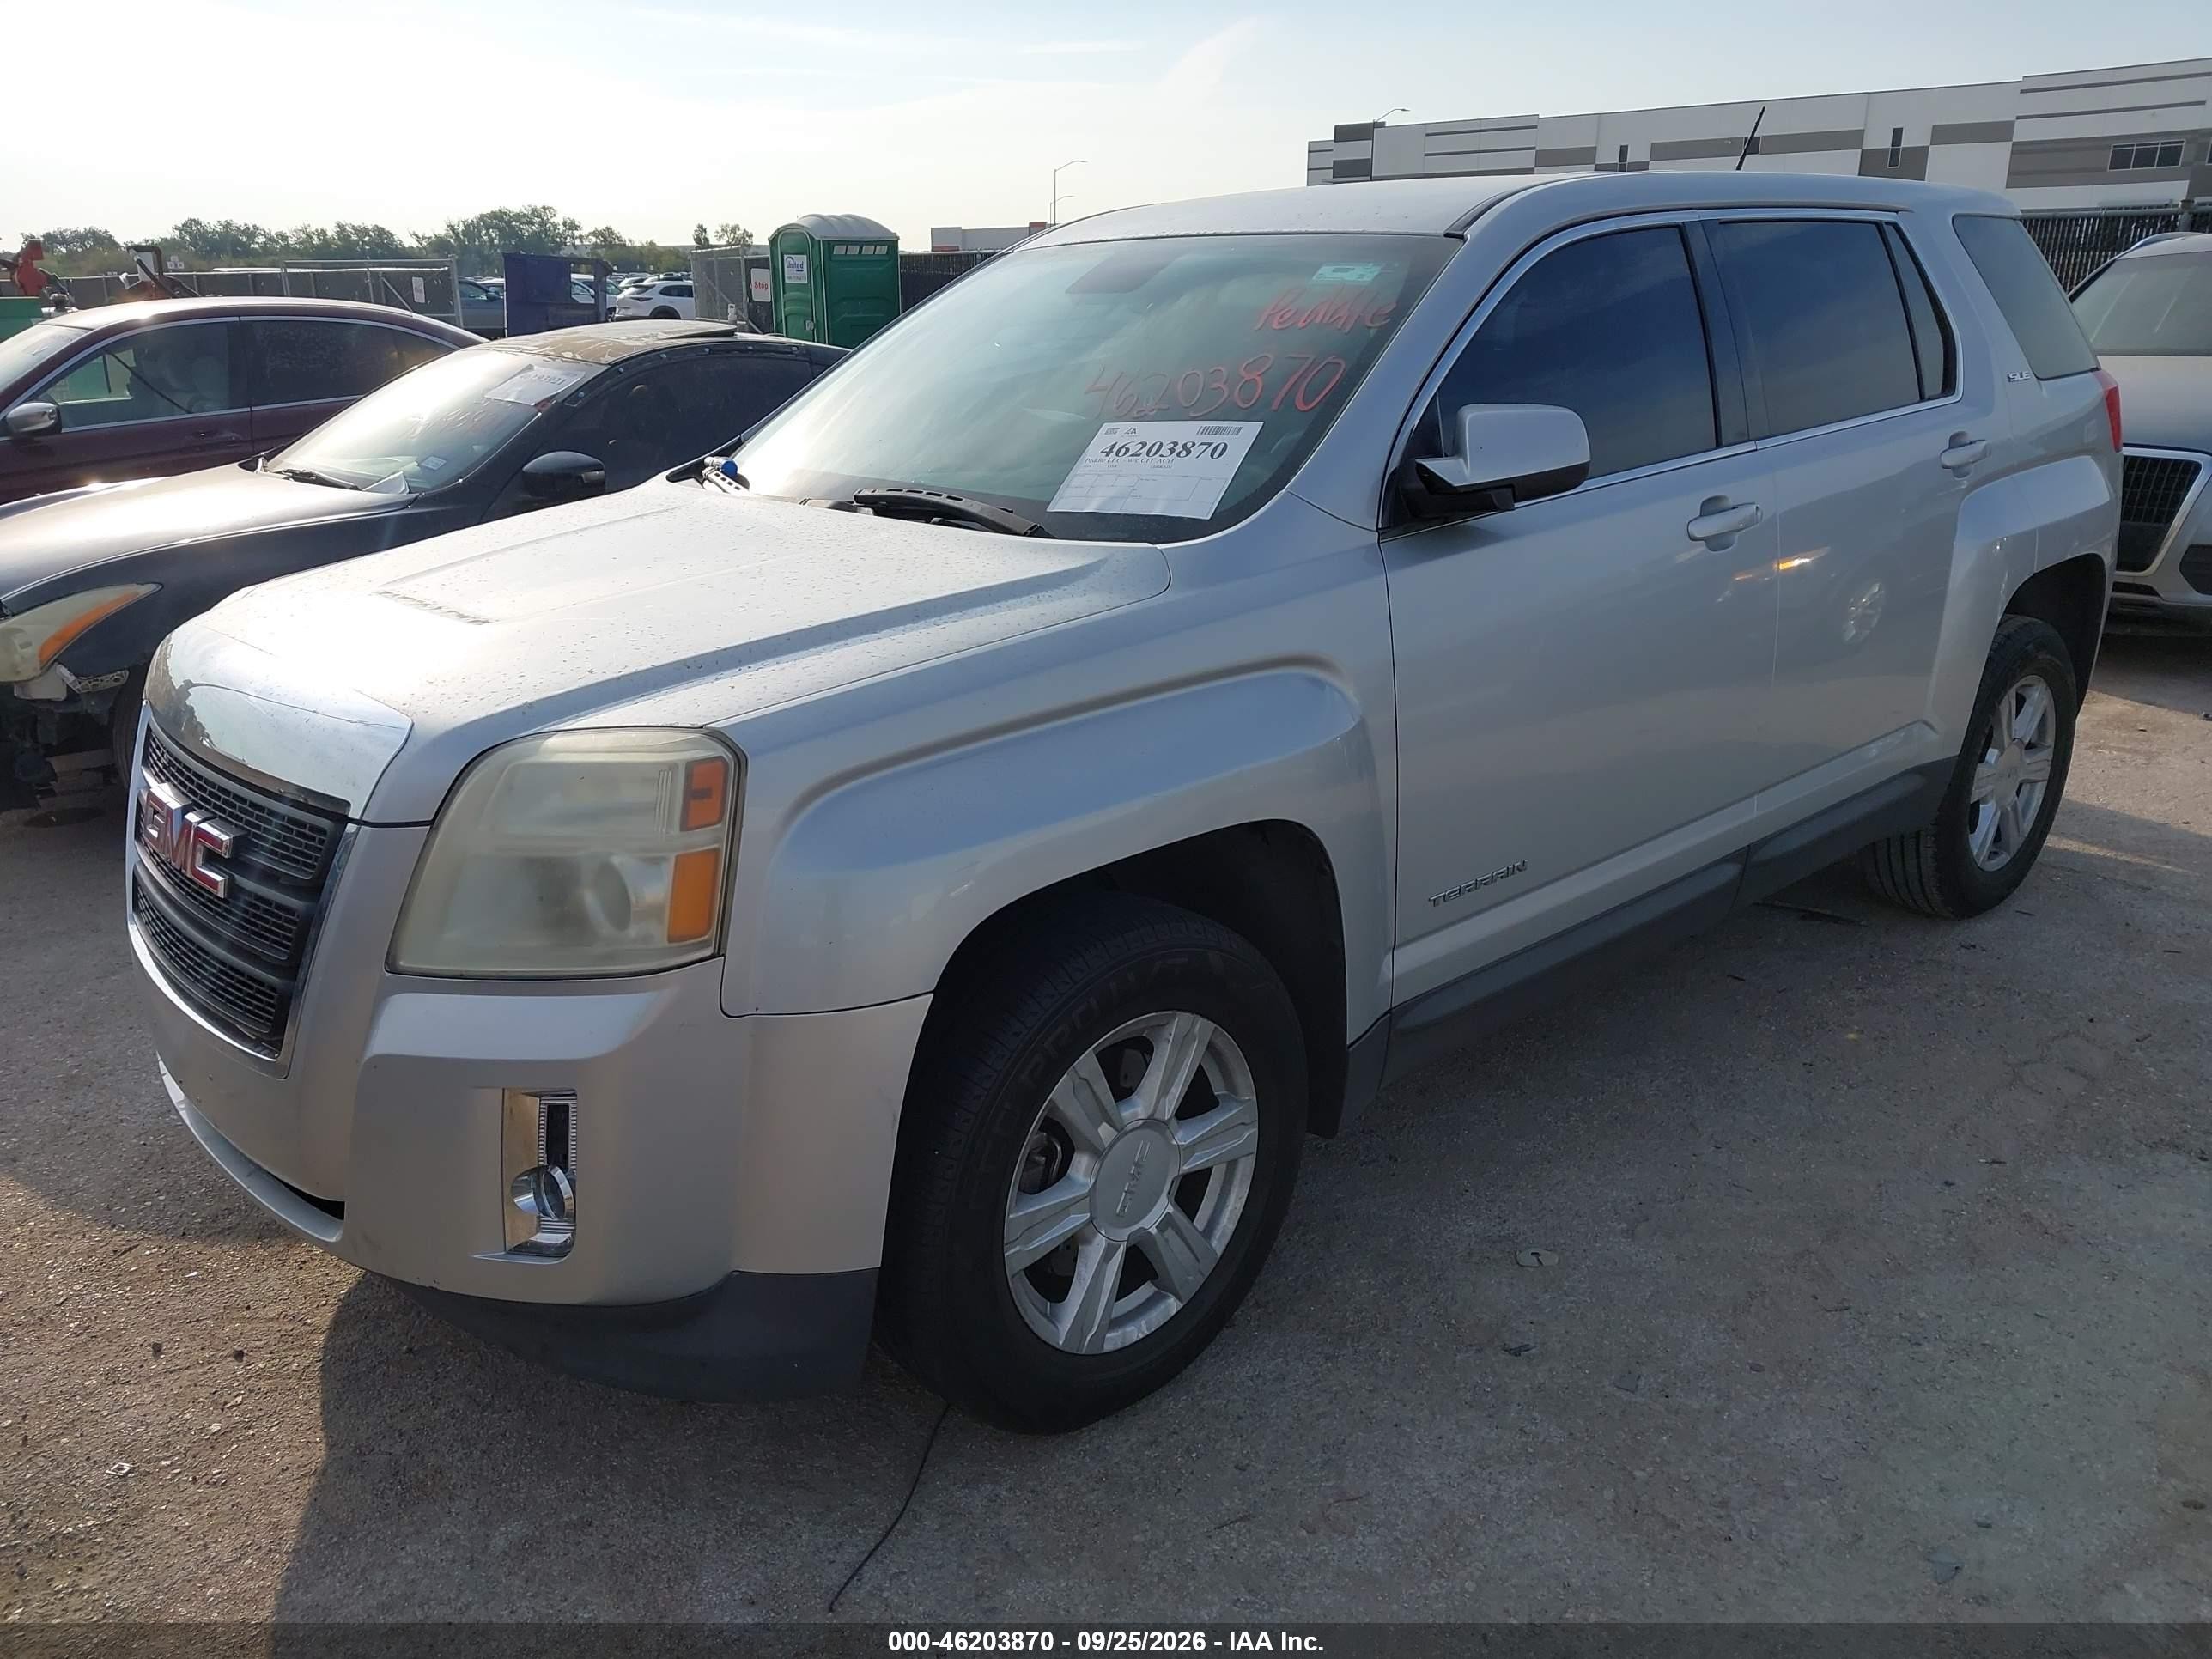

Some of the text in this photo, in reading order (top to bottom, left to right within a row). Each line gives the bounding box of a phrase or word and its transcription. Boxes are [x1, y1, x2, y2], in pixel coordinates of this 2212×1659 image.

[754, 281, 769, 290] Stop
[1084, 353, 1346, 420] 46203870
[2008, 371, 2030, 382] SLE
[1100, 441, 1228, 459] 46203870
[138, 782, 234, 899] GMC
[1428, 859, 1528, 907] TERRAIN
